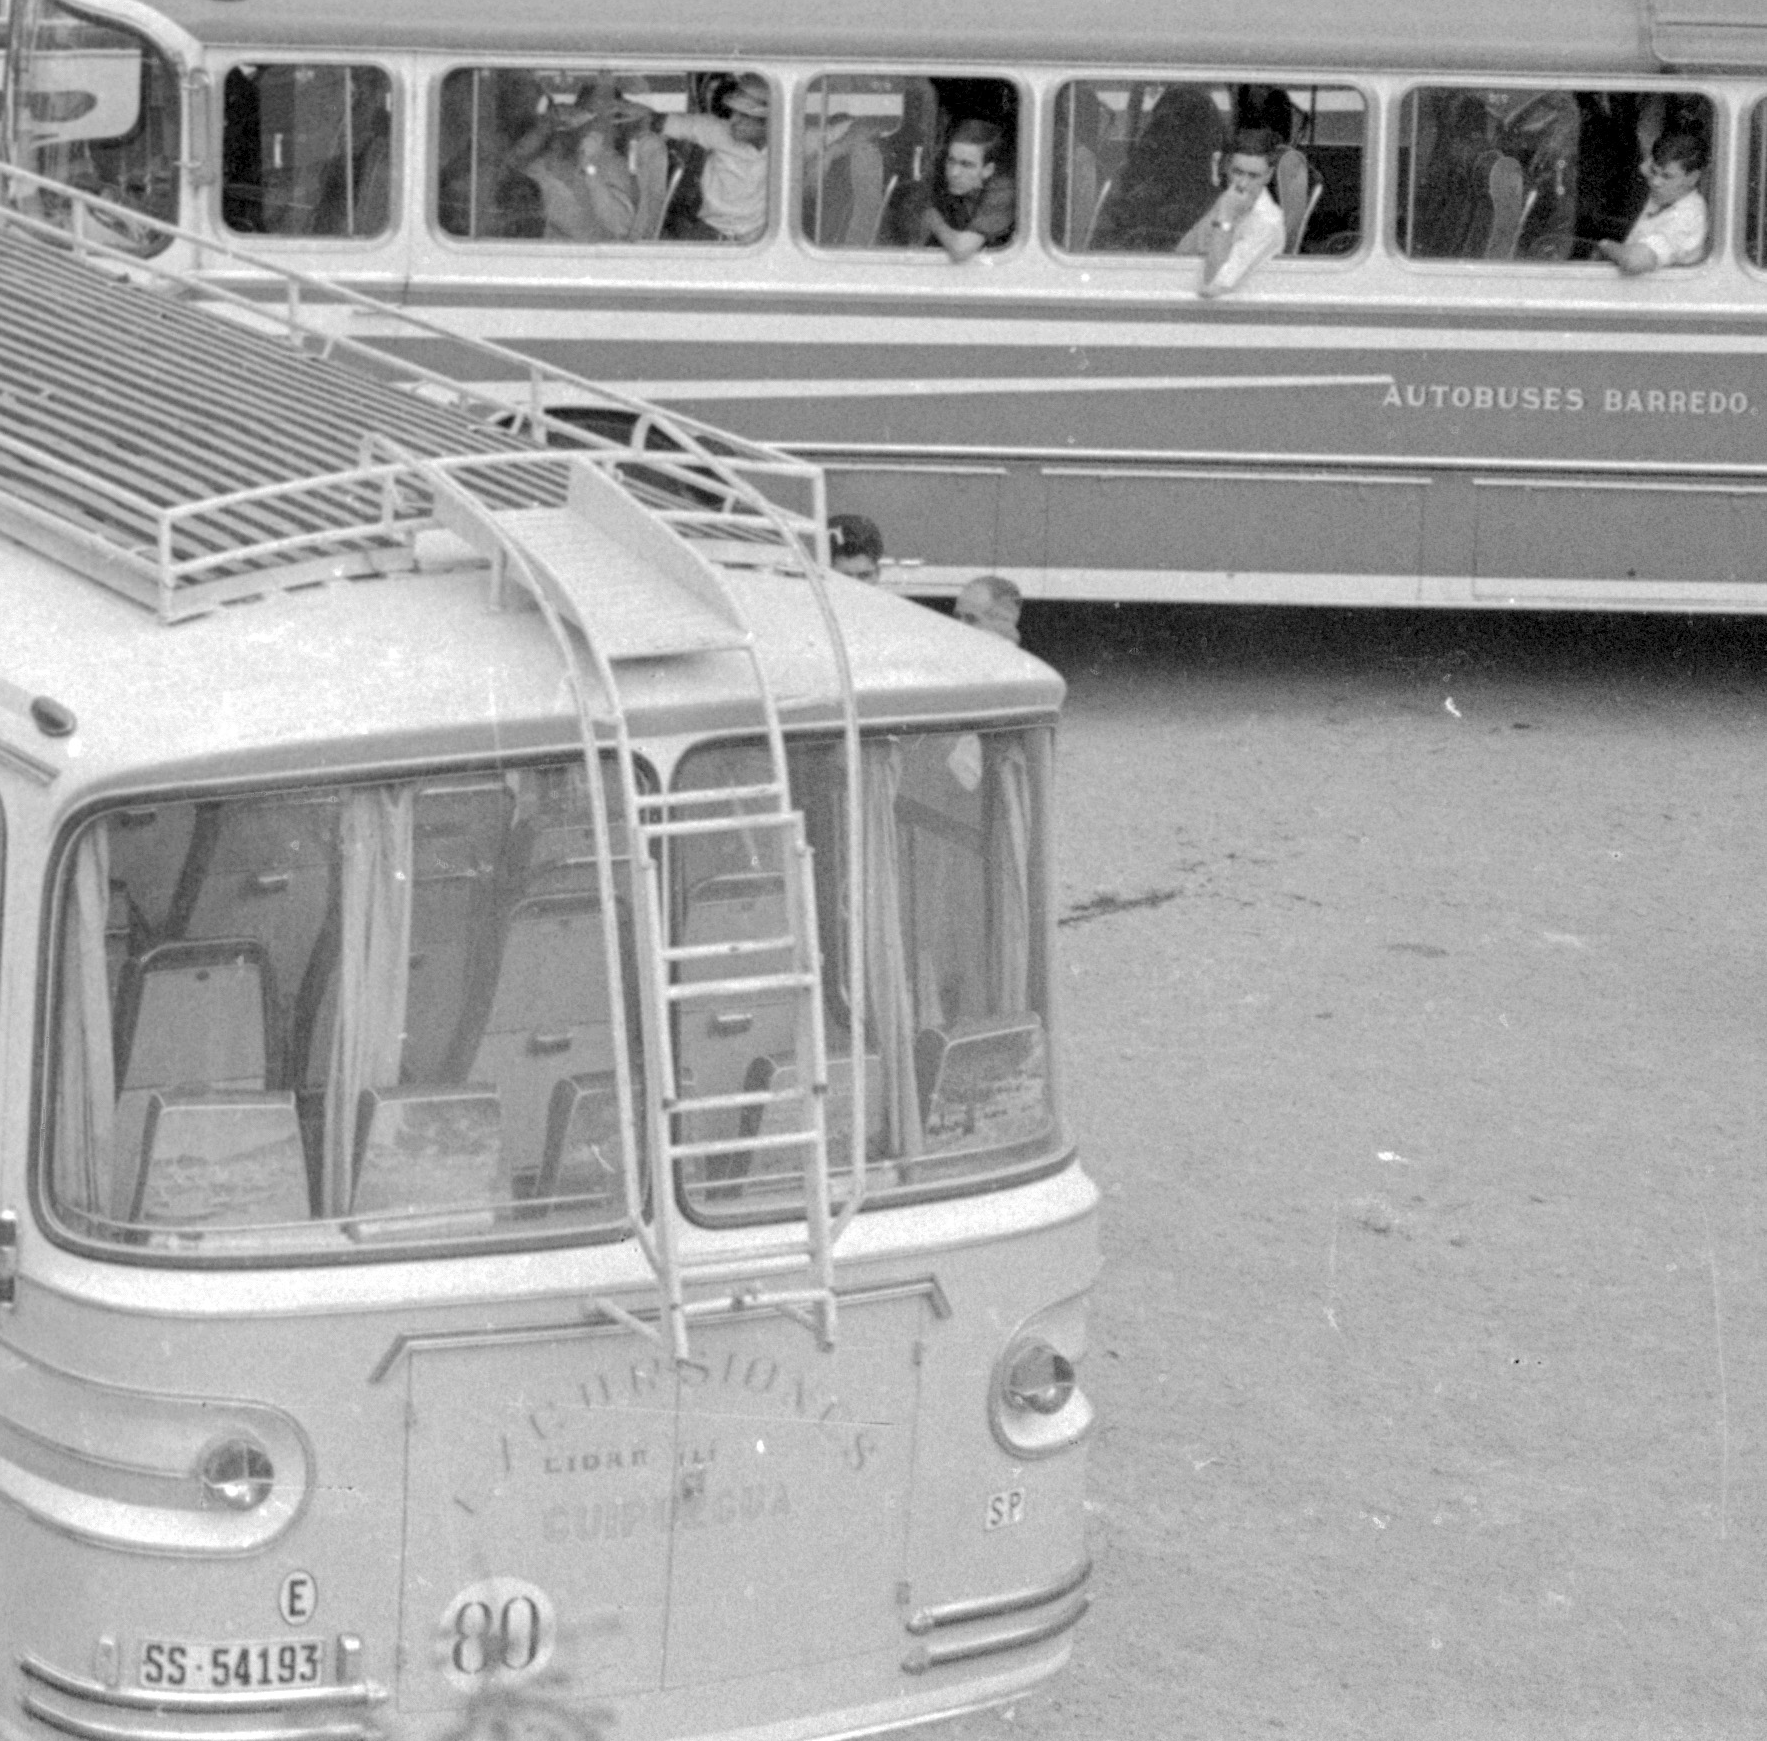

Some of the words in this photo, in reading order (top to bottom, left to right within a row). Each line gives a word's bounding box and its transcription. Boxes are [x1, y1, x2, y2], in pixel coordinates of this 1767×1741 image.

[1381, 383, 1585, 411] AUTOBUSES
[1604, 388, 1749, 416] BARREDO
[989, 1491, 1023, 1526] SP
[289, 1578, 309, 1618] E
[451, 1595, 541, 1676] 80
